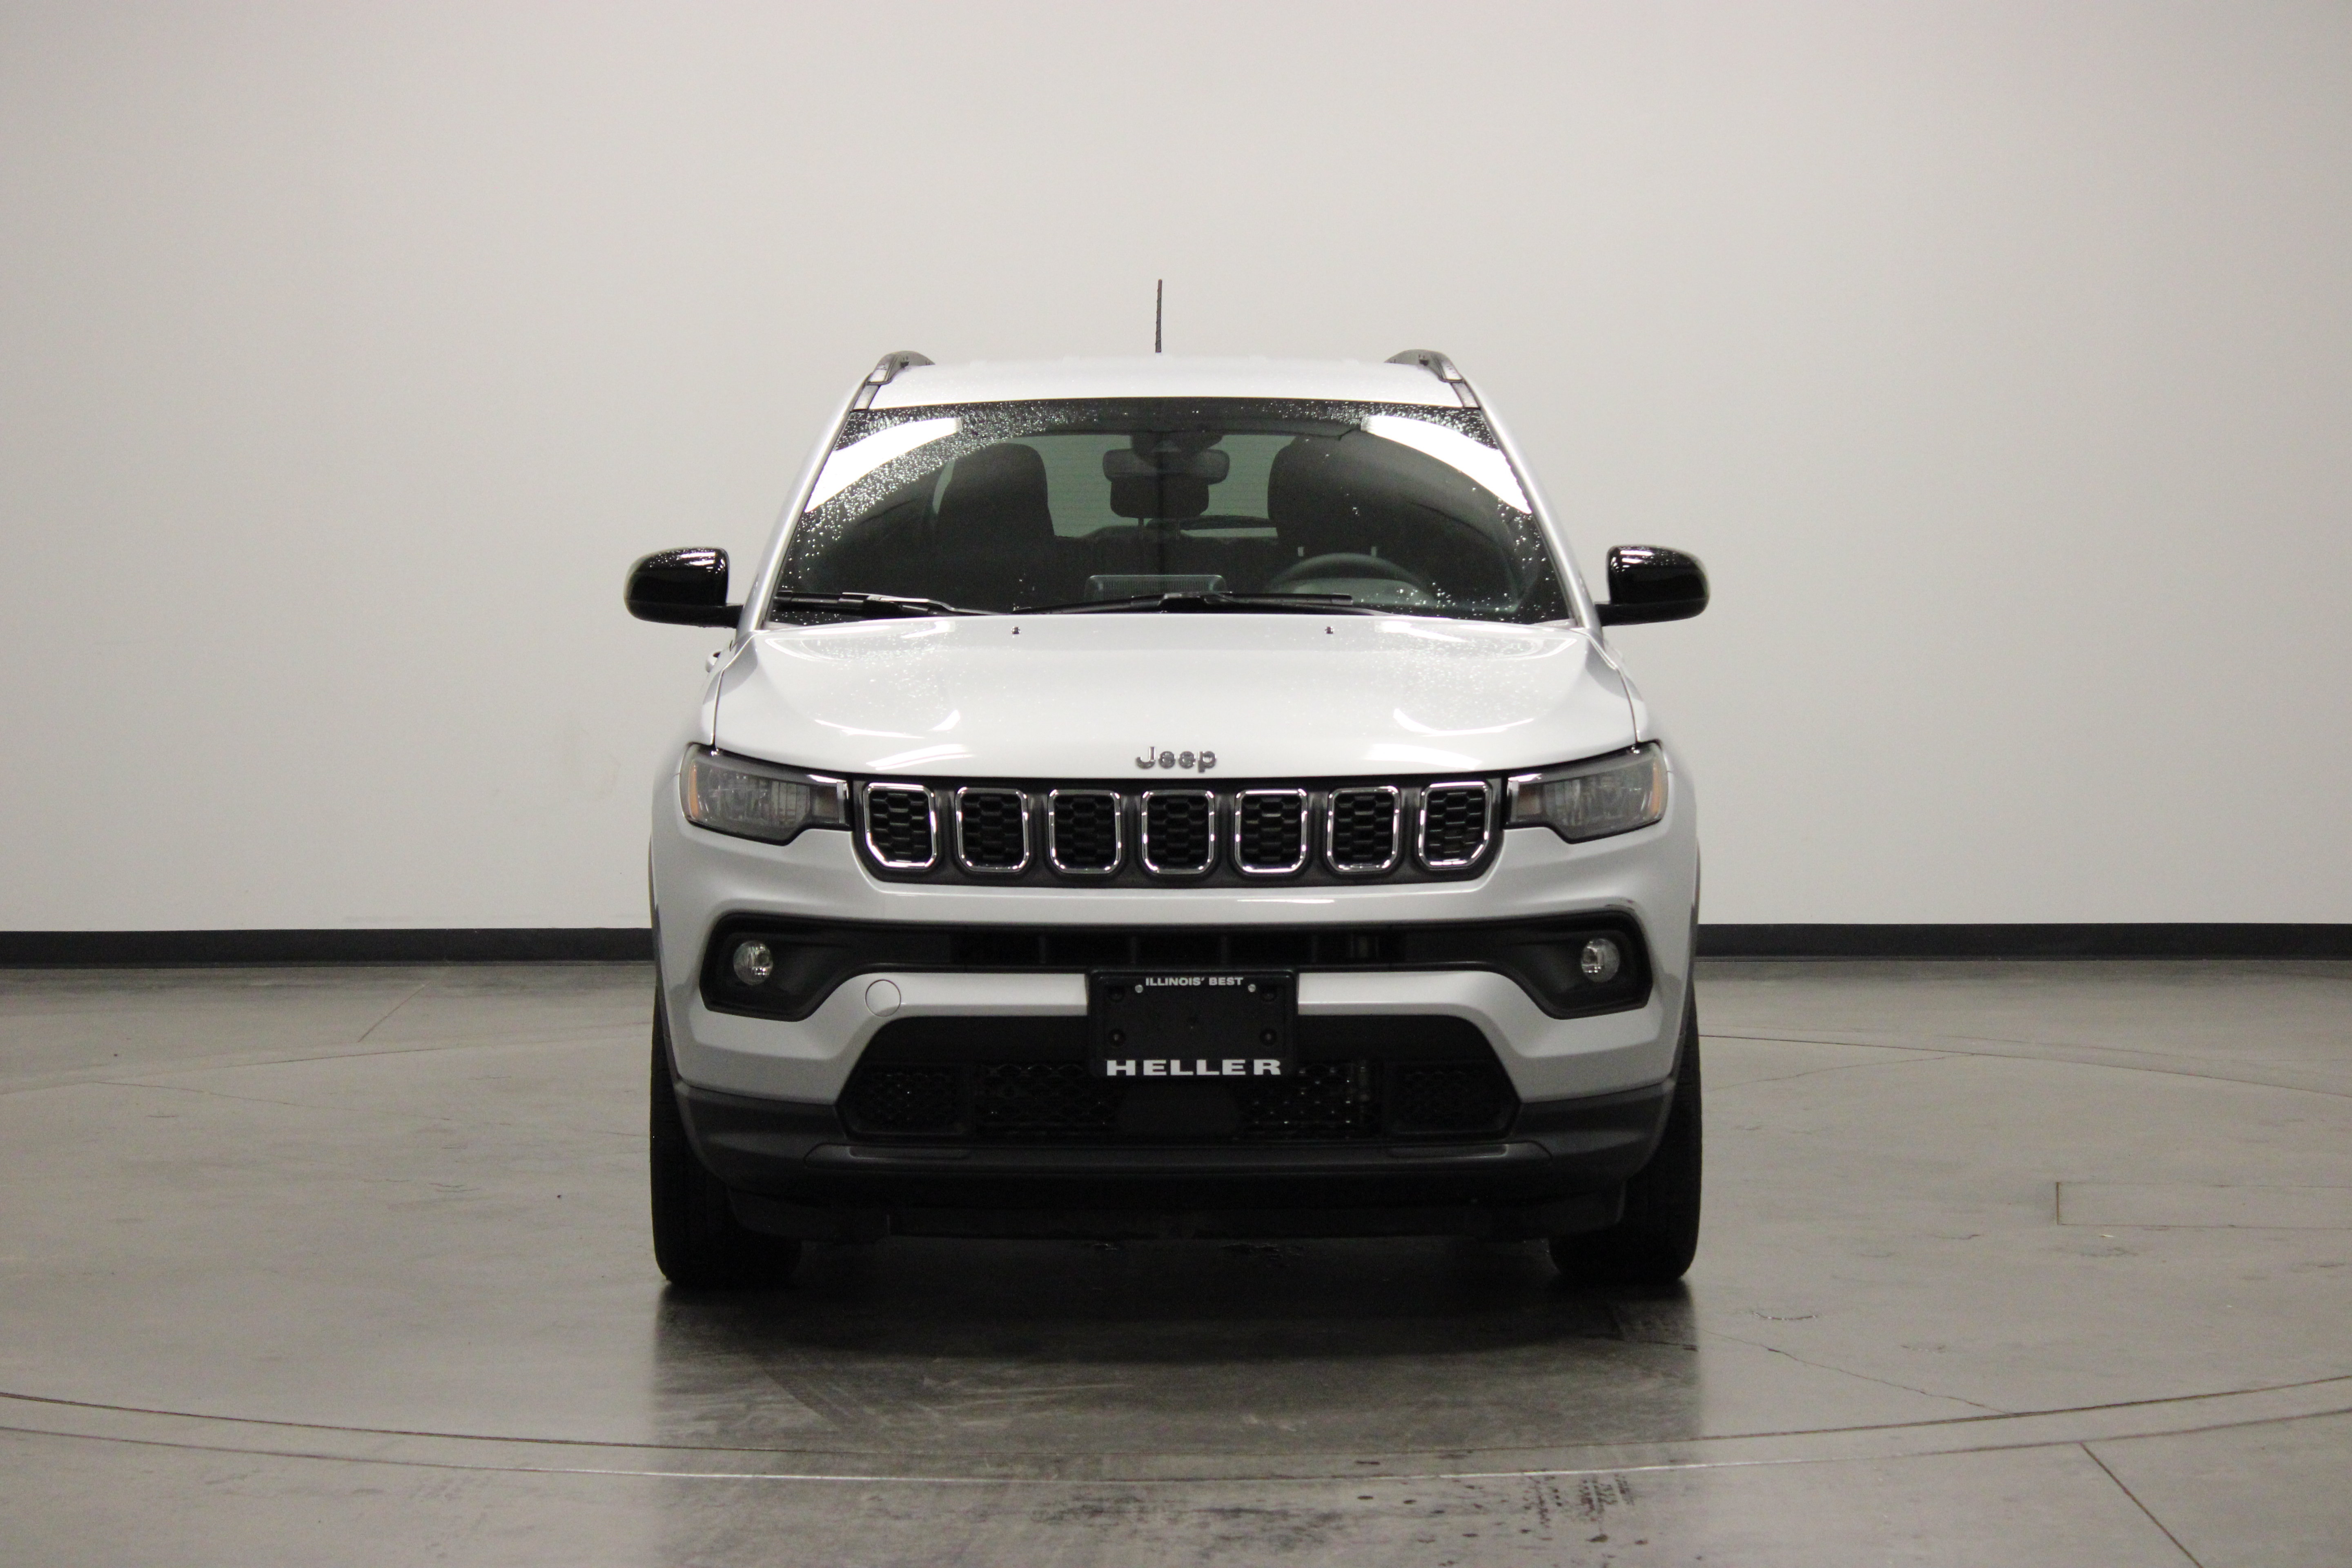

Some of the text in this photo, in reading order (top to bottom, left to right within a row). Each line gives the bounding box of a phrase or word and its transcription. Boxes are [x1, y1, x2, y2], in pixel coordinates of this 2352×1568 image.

[1136, 746, 1216, 773] Jeep
[1145, 977, 1243, 986] ILLINOIS' BEST
[1107, 1059, 1281, 1076] HELLER
